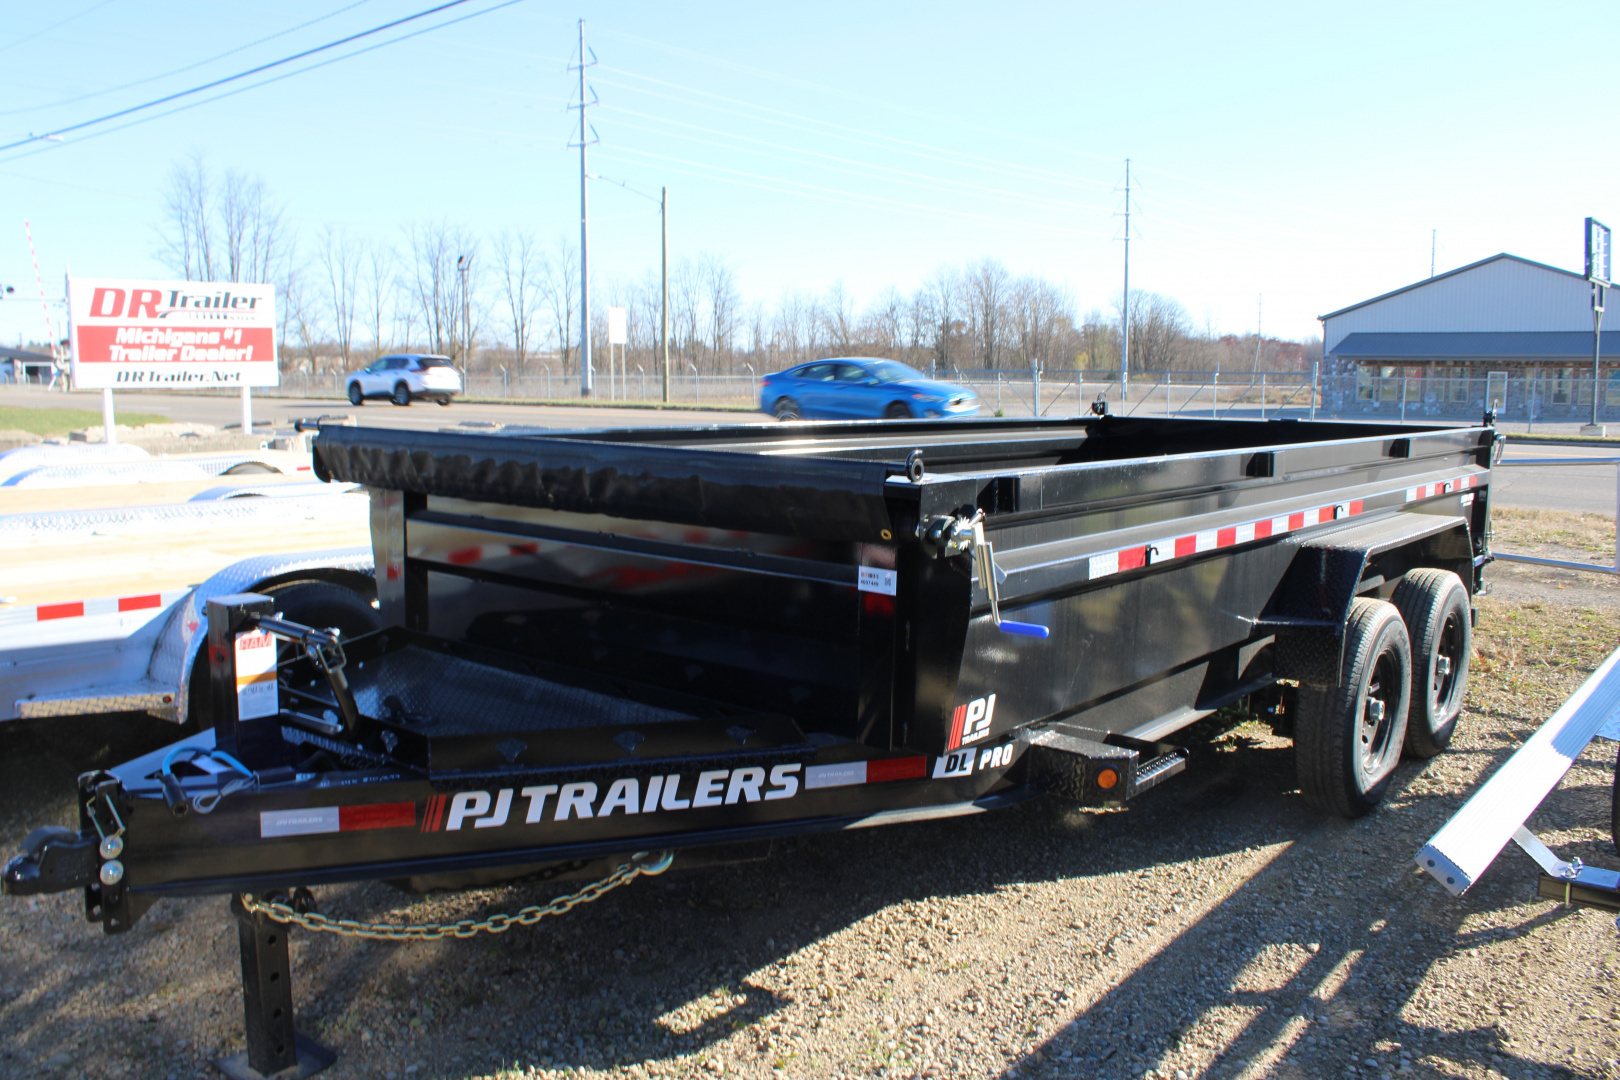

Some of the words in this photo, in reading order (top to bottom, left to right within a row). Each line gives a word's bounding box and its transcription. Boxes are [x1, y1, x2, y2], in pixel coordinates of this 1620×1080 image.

[89, 288, 163, 319] DR
[167, 290, 263, 310] Trailer
[109, 344, 178, 362] Trailer
[240, 634, 272, 650] RAM
[962, 693, 997, 736] PJ
[961, 727, 991, 746] TRAILERS
[944, 752, 967, 773] DL
[978, 743, 1014, 770] PRO
[445, 788, 514, 832] PJ
[521, 763, 802, 825] TRAILERS
